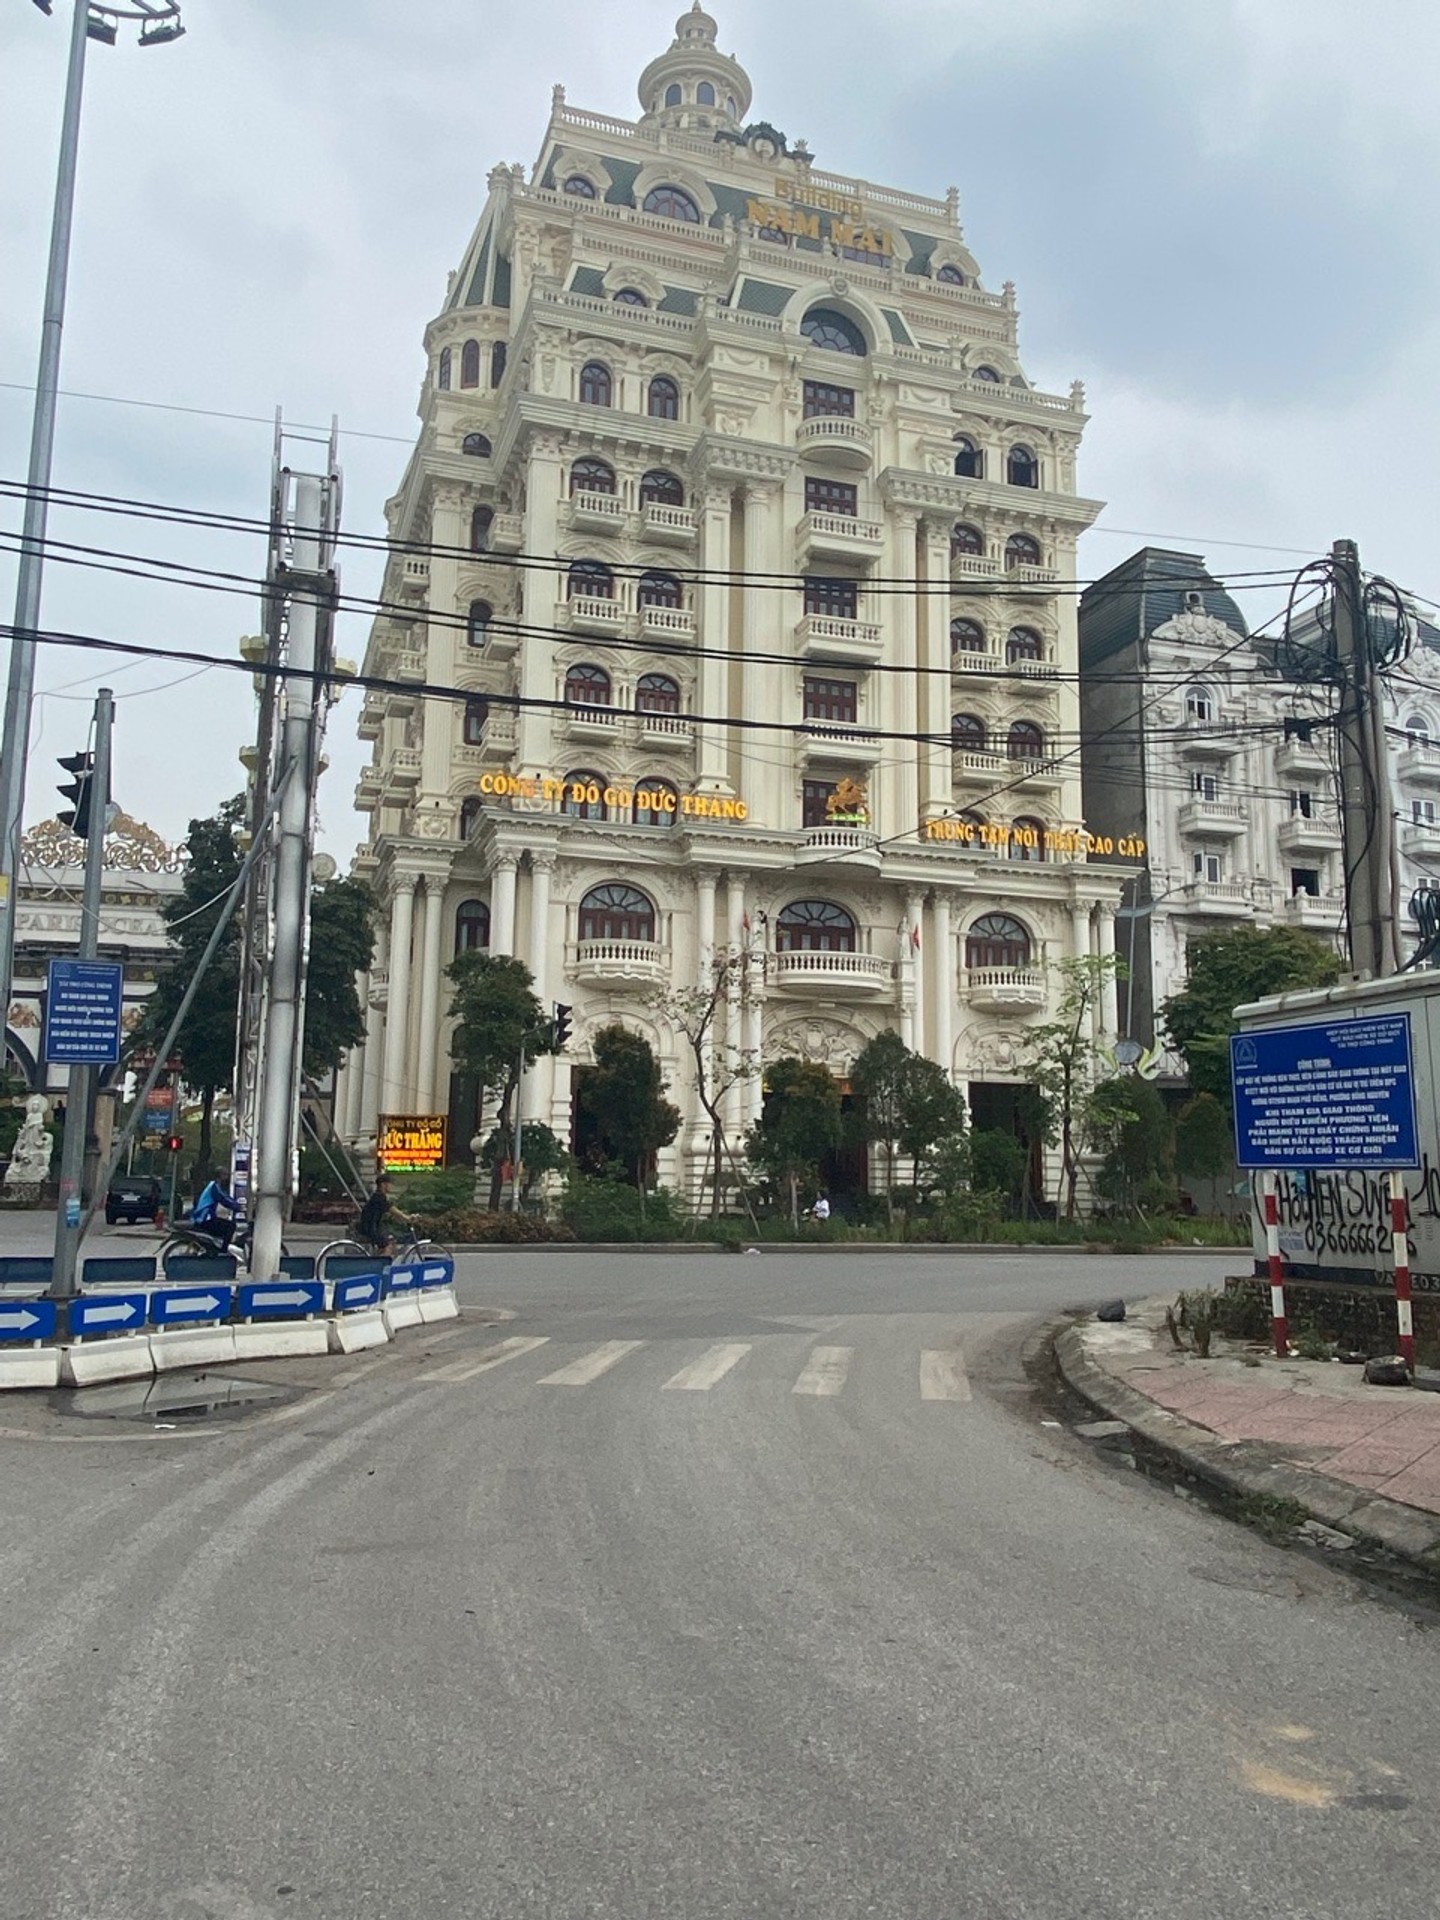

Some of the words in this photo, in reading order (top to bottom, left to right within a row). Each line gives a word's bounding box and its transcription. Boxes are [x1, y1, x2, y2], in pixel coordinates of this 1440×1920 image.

[775, 177, 863, 222] Building
[747, 198, 821, 241] NAM
[830, 218, 892, 255] MAI
[480, 769, 535, 798] CÔNG
[542, 780, 567, 801] TY
[638, 784, 676, 814] ĐỨC
[1087, 835, 1113, 855] CAO
[1118, 831, 1145, 858] CẤP
